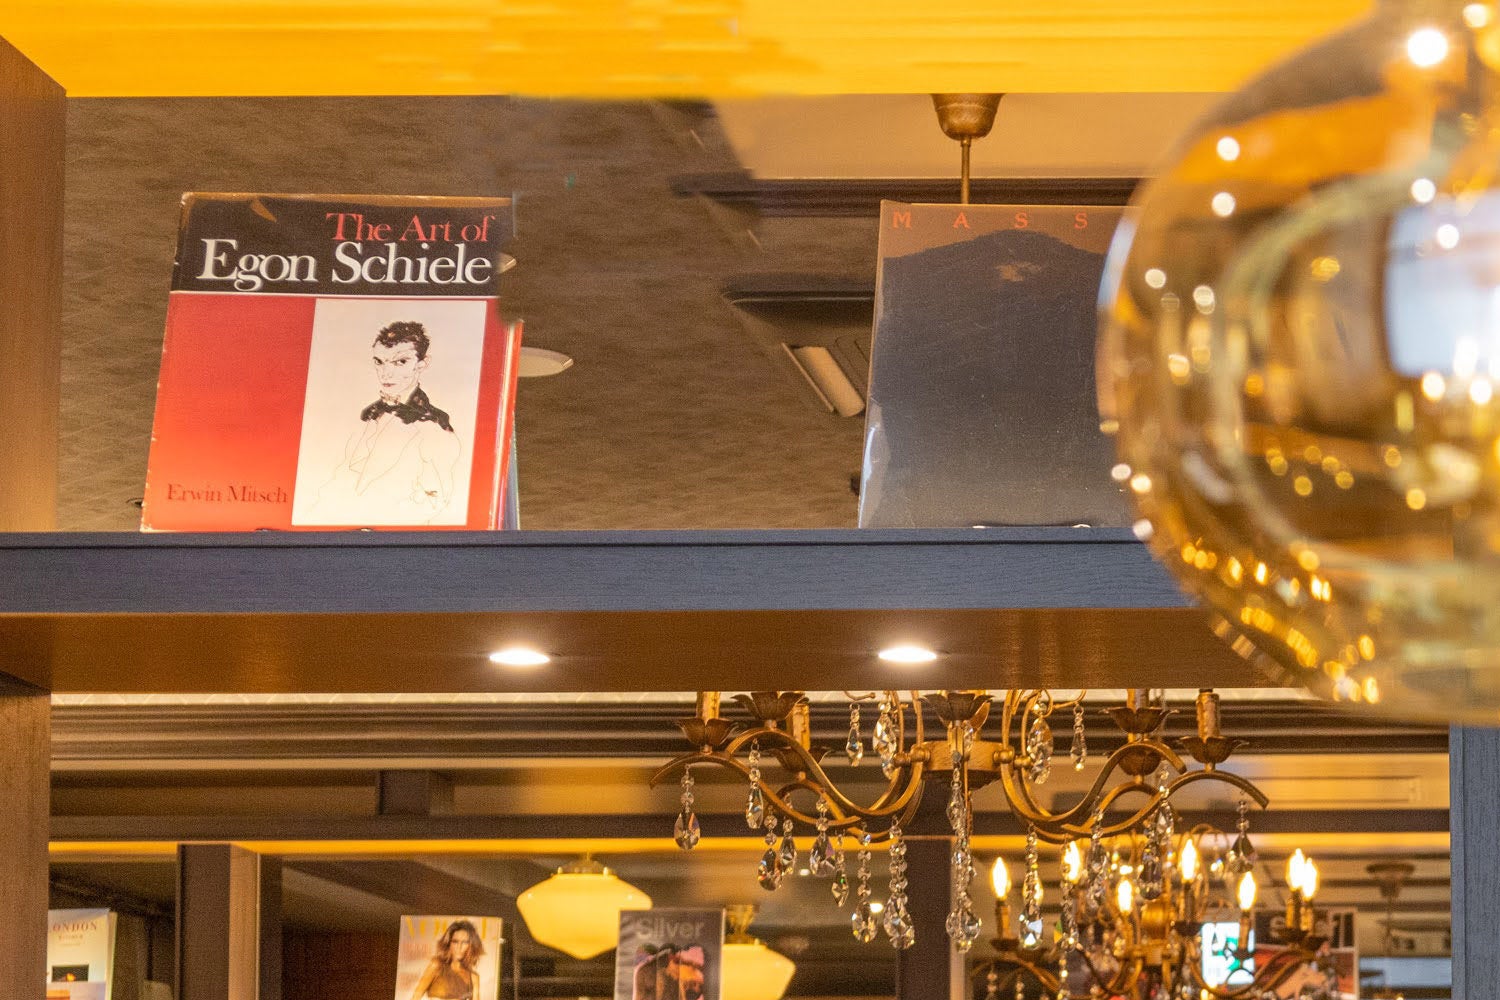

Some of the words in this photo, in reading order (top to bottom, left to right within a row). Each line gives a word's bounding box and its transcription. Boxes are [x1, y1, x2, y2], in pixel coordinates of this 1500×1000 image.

[326, 212, 391, 241] The
[401, 215, 452, 242] Art
[460, 214, 494, 242] of
[196, 238, 319, 292] Egon
[331, 241, 491, 285] Schiele
[167, 483, 222, 501] Erwin
[228, 485, 287, 503] Mitsch
[636, 917, 705, 939] Silver
